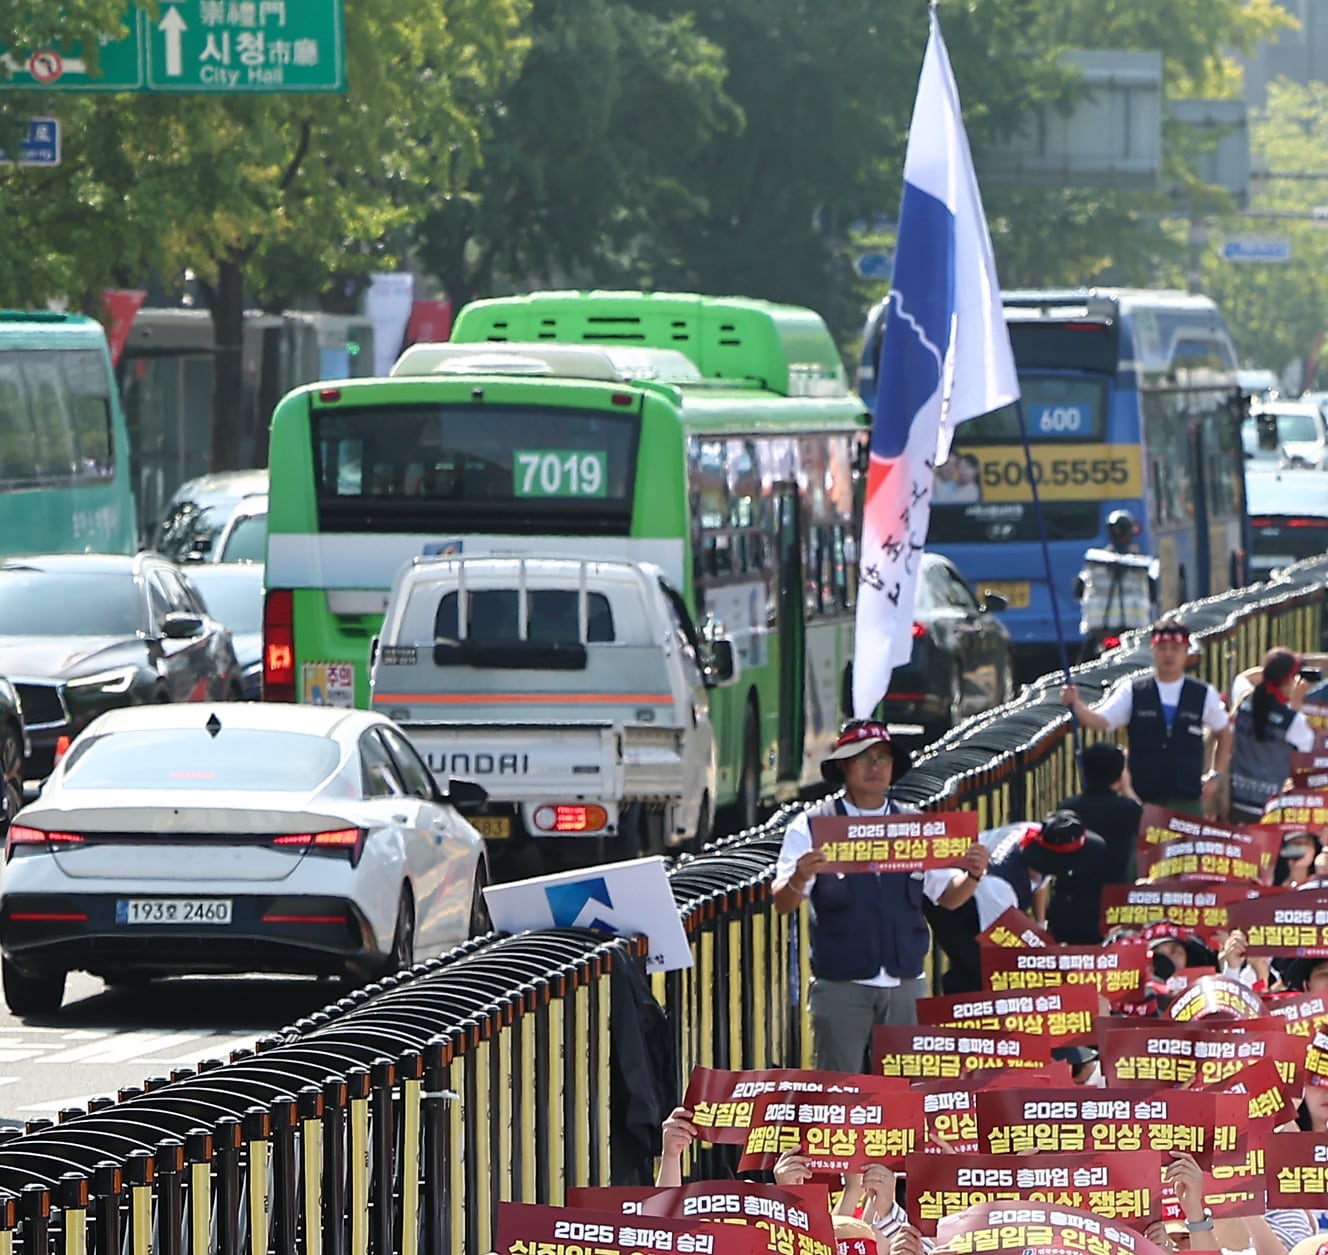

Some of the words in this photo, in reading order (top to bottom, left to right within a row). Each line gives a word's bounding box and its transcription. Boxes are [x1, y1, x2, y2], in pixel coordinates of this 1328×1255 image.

[200, 66, 239, 87] City
[248, 66, 284, 83] Hall
[1040, 406, 1080, 432] 600
[518, 454, 601, 494] 7019
[183, 902, 228, 921] 2460
